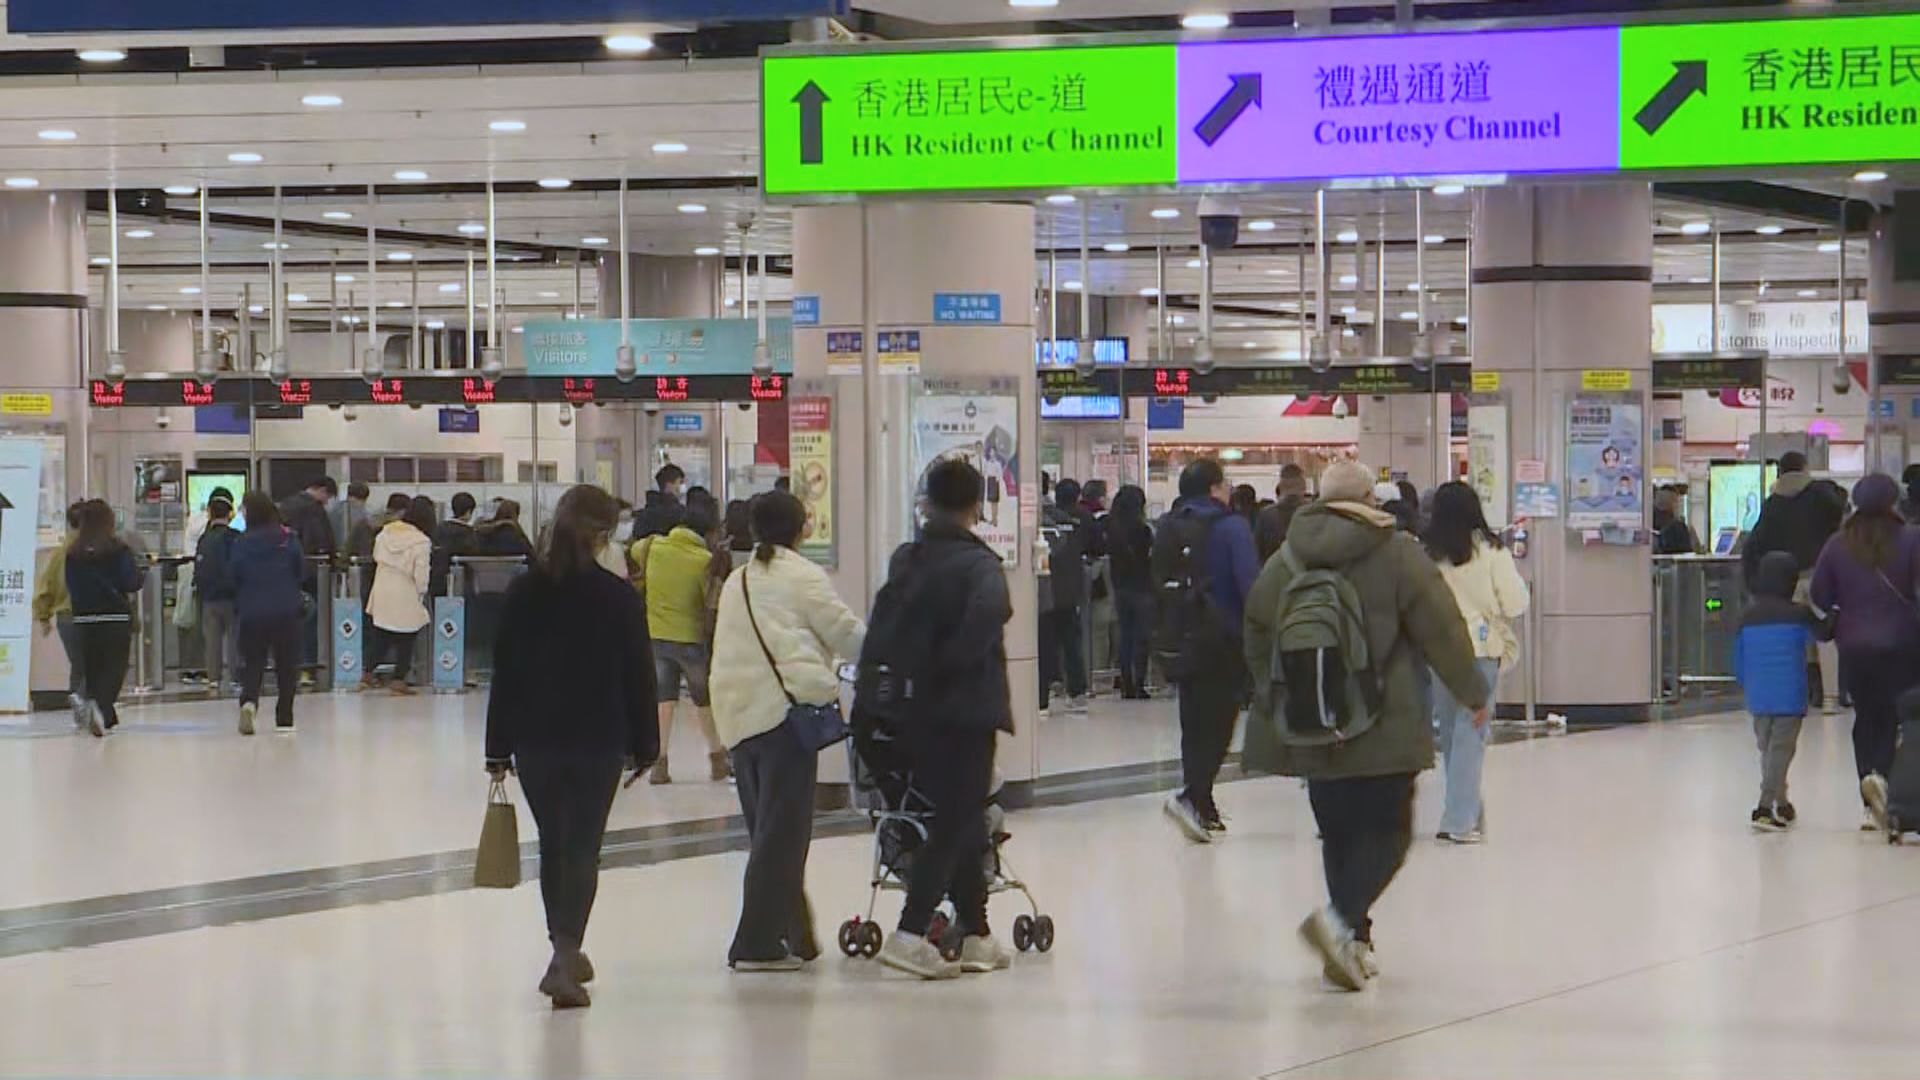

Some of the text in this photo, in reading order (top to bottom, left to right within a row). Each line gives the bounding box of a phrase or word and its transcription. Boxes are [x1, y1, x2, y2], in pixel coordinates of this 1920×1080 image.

[1314, 60, 1491, 109] 禮遇通道
[1744, 45, 1920, 92] 香港居民
[854, 72, 1087, 119] 香港居民e-道
[1314, 111, 1561, 148] Courtesy Channel
[1742, 104, 1791, 130] HK
[852, 125, 1163, 157] HK Resident e-Channel
[534, 349, 587, 363] Visitors
